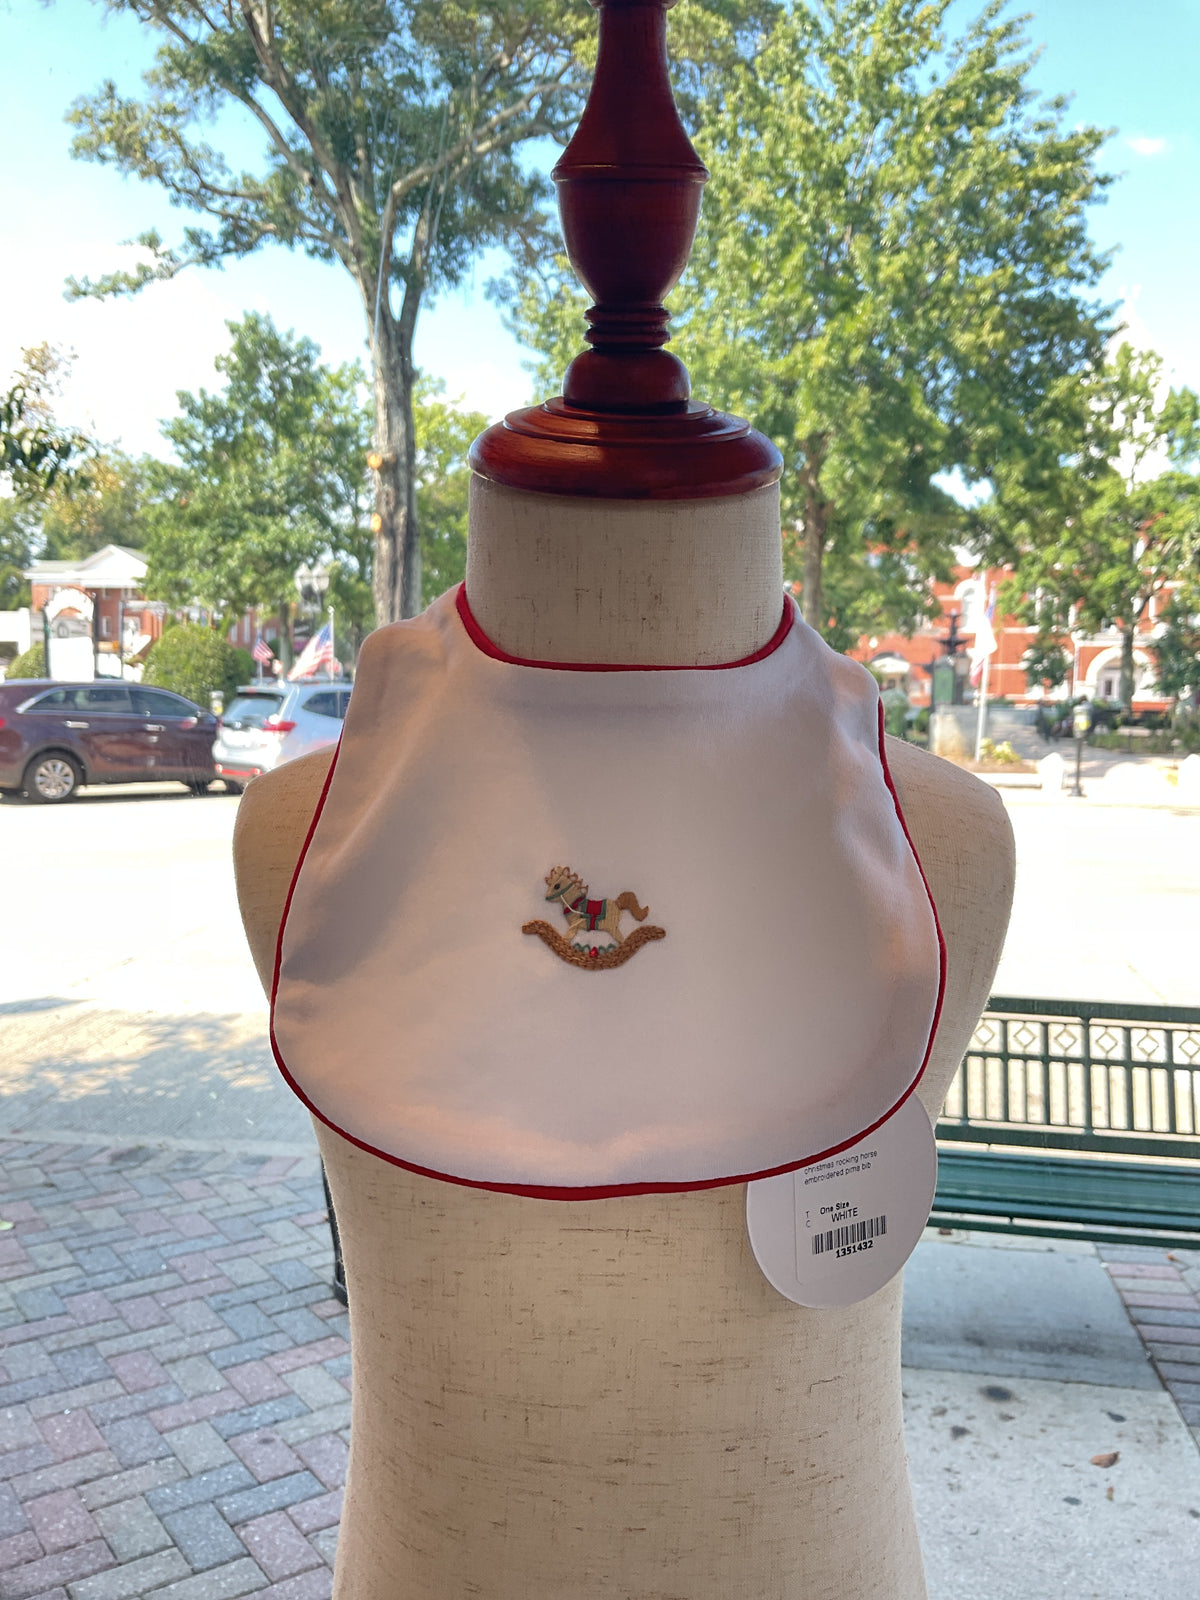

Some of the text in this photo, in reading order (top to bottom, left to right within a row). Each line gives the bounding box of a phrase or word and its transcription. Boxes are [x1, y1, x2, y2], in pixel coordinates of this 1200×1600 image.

[836, 1155, 859, 1166] rocking
[860, 1150, 878, 1160] horse
[804, 1169, 844, 1185] embroidered
[861, 1161, 872, 1170] bib
[820, 1201, 850, 1215] One Size
[831, 1207, 858, 1223] WHITE
[836, 1240, 874, 1258] 1351432
